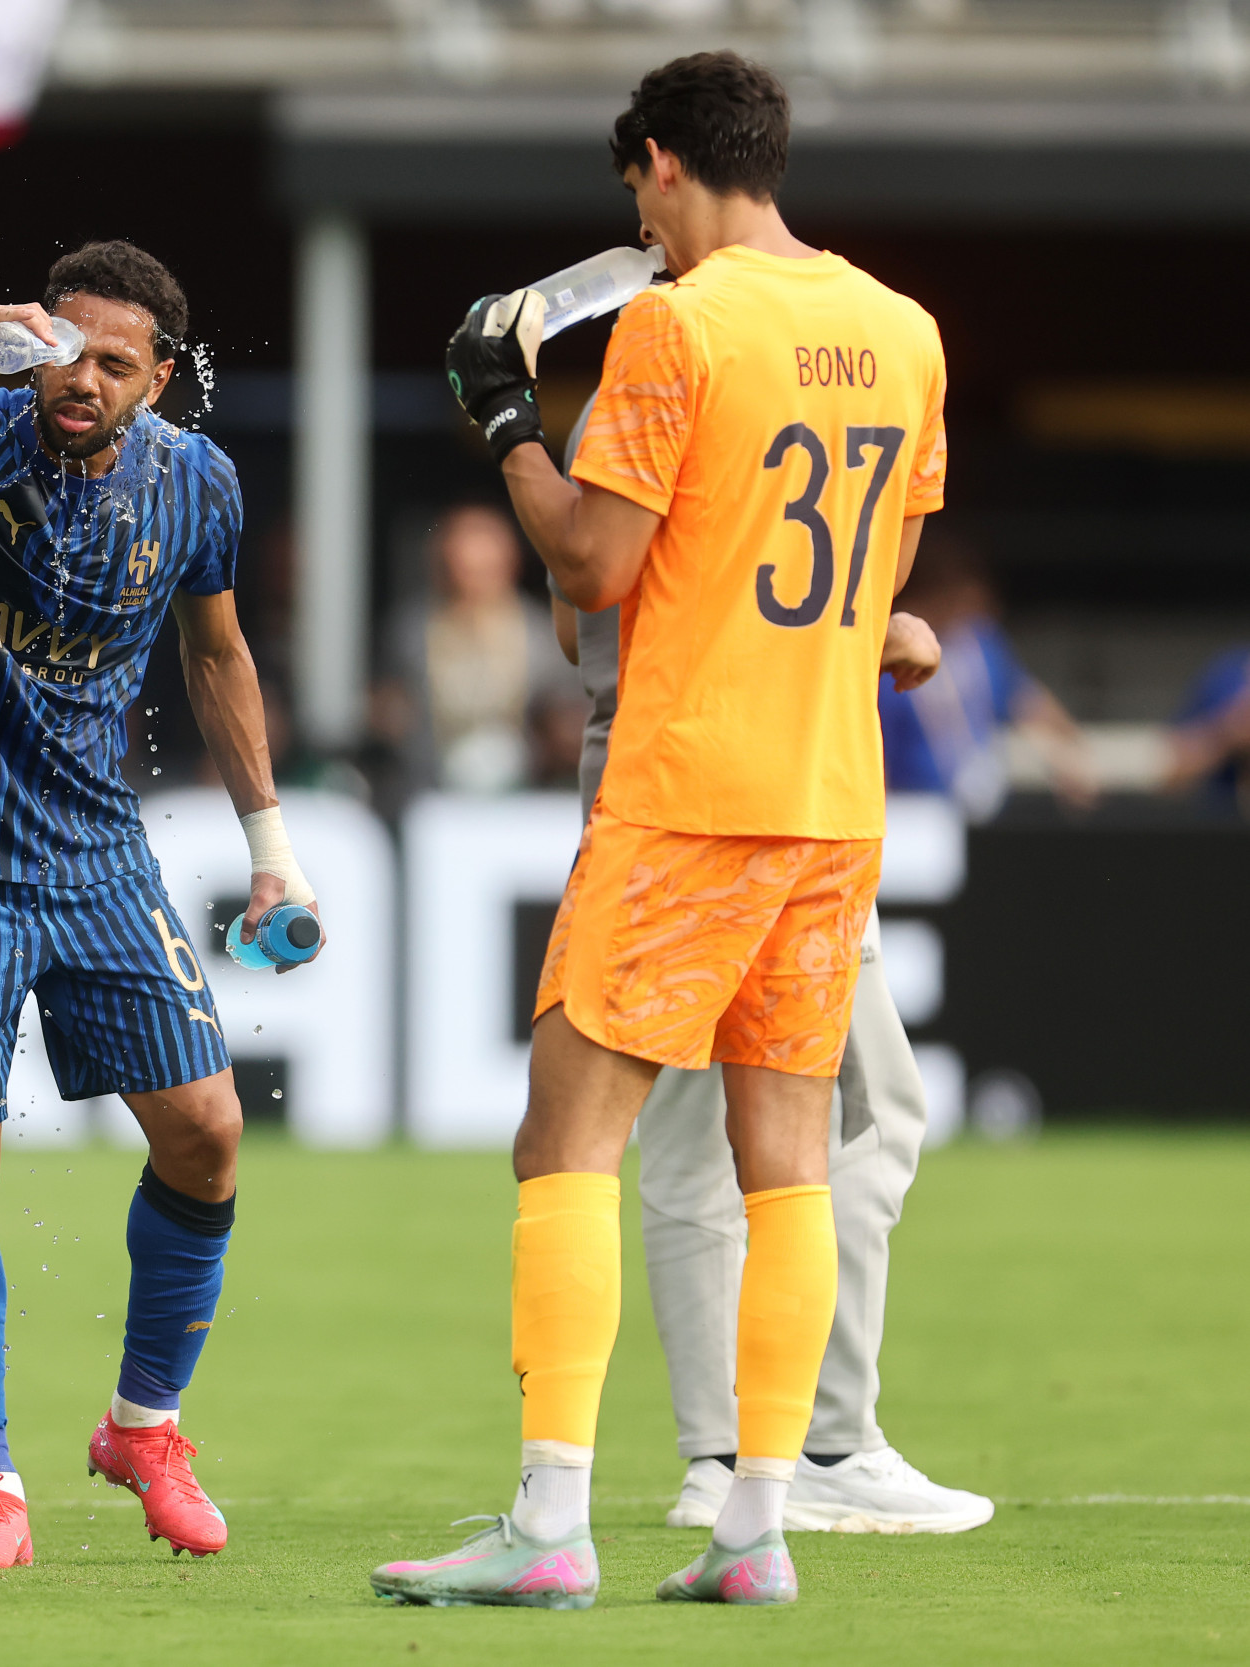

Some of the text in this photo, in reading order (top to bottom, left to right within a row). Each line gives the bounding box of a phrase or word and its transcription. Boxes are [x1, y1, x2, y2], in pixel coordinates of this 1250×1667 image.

[795, 346, 877, 389] BONO
[755, 421, 906, 628] 37
[119, 586, 149, 597] ALHILAL
[21, 662, 84, 686] GROU
[150, 907, 205, 992] 6
